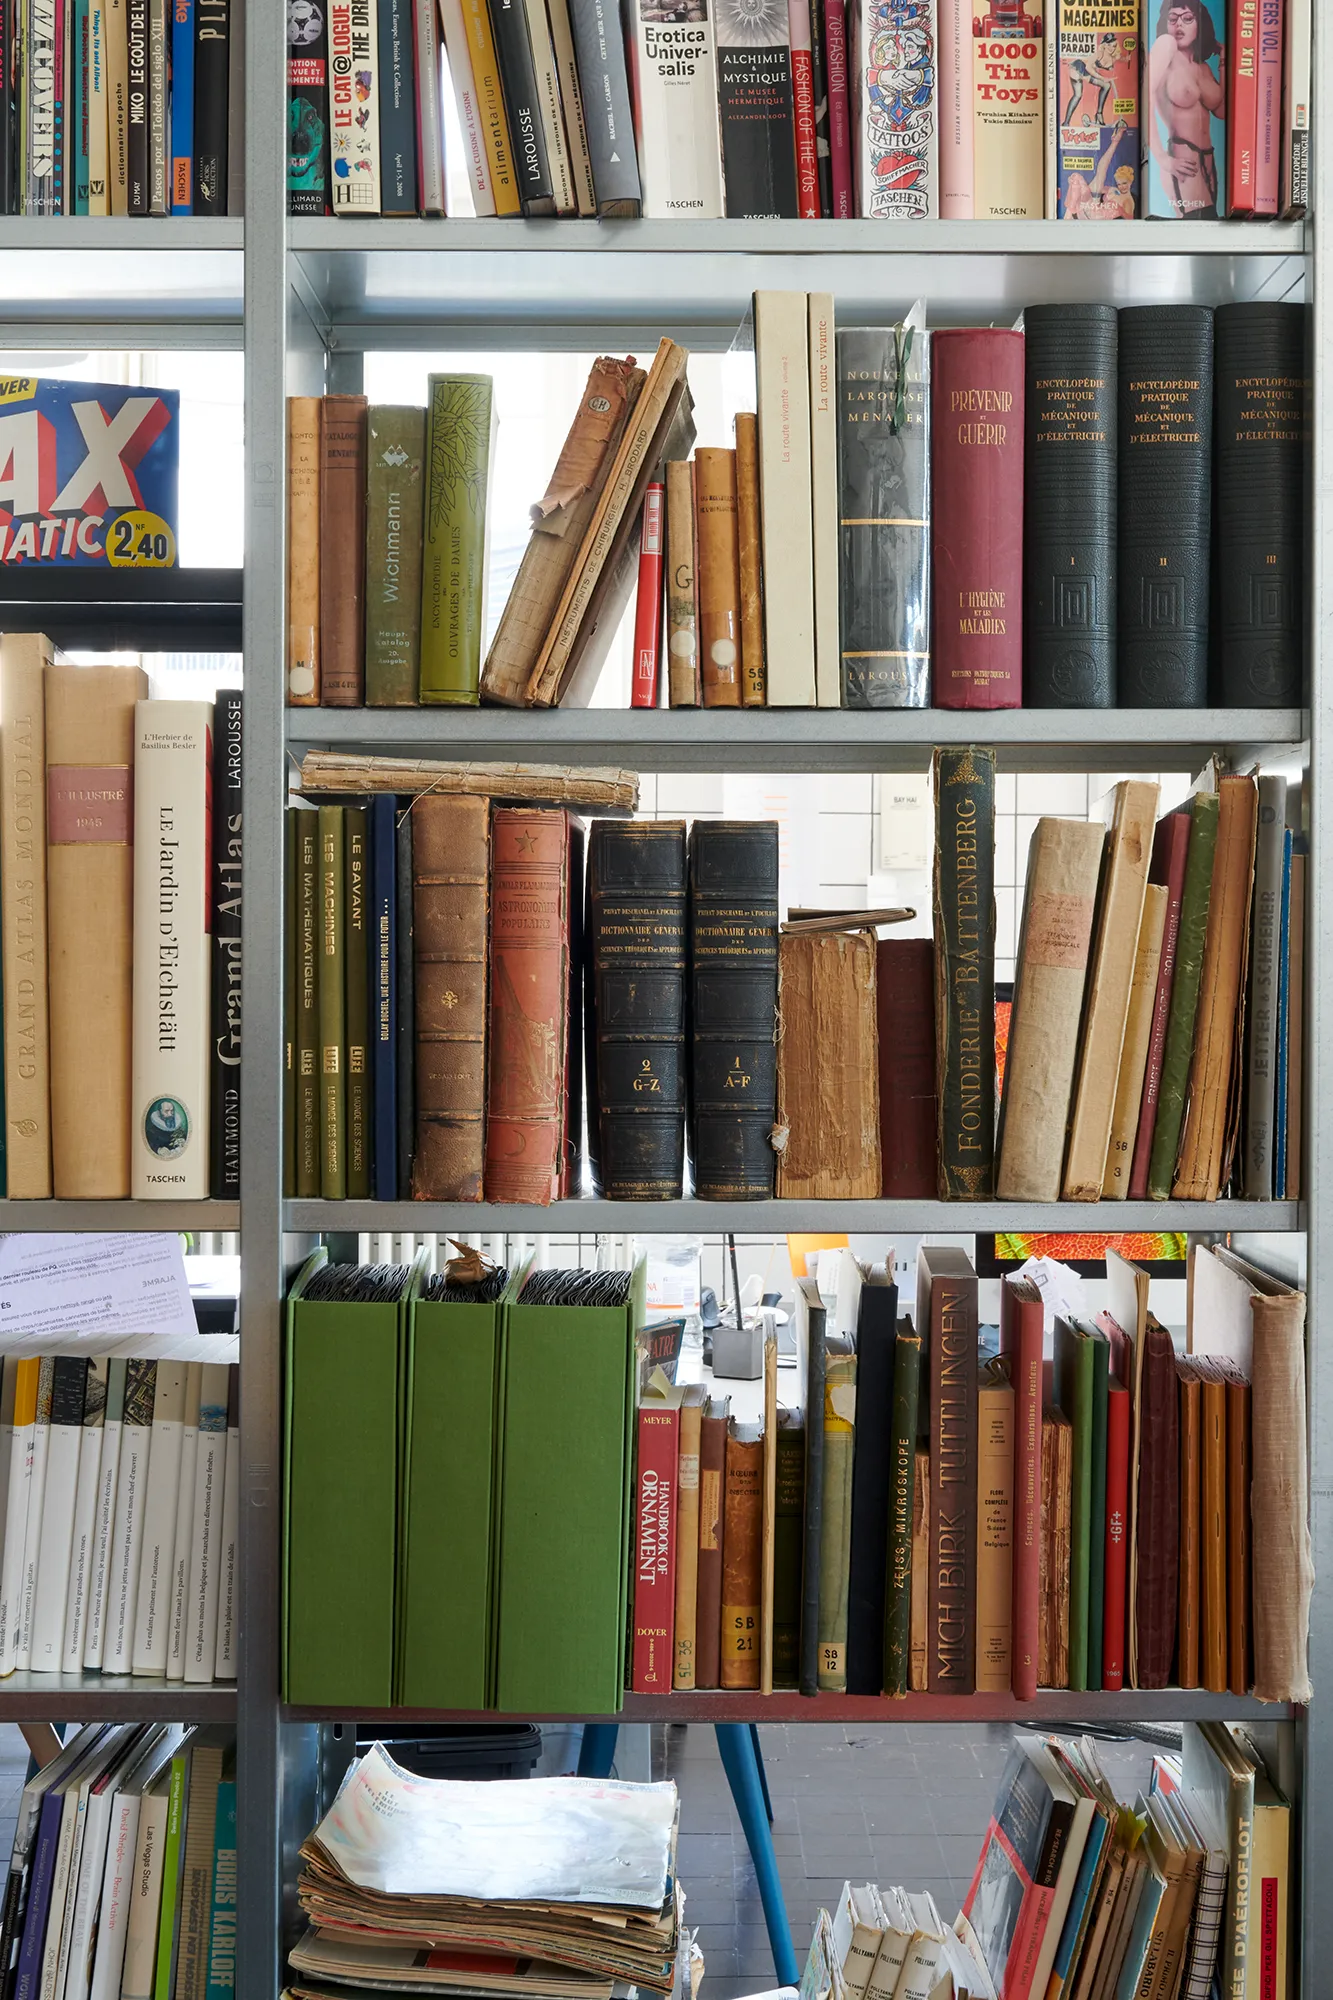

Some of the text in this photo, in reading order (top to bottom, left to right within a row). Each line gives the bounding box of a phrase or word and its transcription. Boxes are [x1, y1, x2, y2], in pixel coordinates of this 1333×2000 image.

[1063, 9, 1135, 28] MAGAZINES
[644, 26, 706, 43] Erotica
[1060, 33, 1095, 42] BEAUTY
[393, 40, 401, 63] British
[646, 43, 708, 59] Univer-
[723, 53, 786, 64] ALCHIMIE
[977, 42, 1038, 60] 1000
[1060, 43, 1095, 54] PARADE
[332, 4, 352, 128] LE CAT@LOGUE
[393, 63, 401, 71] &
[657, 61, 695, 76] salis
[984, 63, 1031, 80] Tin
[602, 74, 612, 102] CARSON
[723, 72, 788, 85] MYSTIQUE
[795, 56, 812, 113] FASHION
[393, 72, 402, 109] Collections
[976, 83, 1039, 104] Toys
[151, 19, 165, 203] Paseos por el Toledo del siglo XIII
[549, 97, 555, 107] LA
[550, 108, 557, 119] DE
[115, 82, 125, 186] dictionnaire de poche
[607, 112, 616, 140] RACHEL
[798, 117, 814, 135] OF
[870, 125, 928, 147] TATTOOS
[518, 107, 541, 181] LAROUSSE
[552, 121, 562, 155] HISTOIRE
[799, 139, 815, 164] THE
[1241, 150, 1250, 185] MILAN
[178, 162, 187, 200] TASCHEN
[559, 163, 570, 207] RENCONTRE
[665, 200, 704, 208] TASCHEN
[989, 207, 1027, 215] TASCHEN
[1168, 200, 1206, 208] TASCHEN
[816, 320, 829, 412] La route vivante
[1035, 378, 1106, 388] ENCYCLOPÉDIE
[1129, 379, 1200, 391] ENCYCLOPÉDIE
[780, 388, 789, 422] vivante
[950, 389, 1013, 412] PRÉVENIR
[1047, 391, 1095, 402] PRATIQUE
[1140, 393, 1189, 403] PRATIQUE
[1040, 410, 1101, 421] MÉCANIQUE
[1134, 411, 1195, 423] MÉCANIQUE
[781, 424, 790, 449] route
[957, 422, 1007, 445] GUÉRIR
[1036, 431, 1106, 442] D'ÉLECTRICITÉ
[1130, 432, 1200, 443] D'ÉLECTRICITÉ
[781, 451, 790, 463] La
[135, 523, 146, 531] NF
[382, 492, 401, 603] Wichmann
[559, 577, 591, 648] INSTRUMENTS
[587, 561, 597, 574] DE
[593, 503, 620, 557] CHIRURGIE
[618, 481, 628, 492] H.
[623, 429, 648, 478] BRODARD
[448, 526, 462, 658] OUVRAGES DE DAMES
[959, 619, 1006, 634] MALADIES
[141, 742, 197, 750] Basilius Besler
[144, 733, 193, 741] L'Herbier de
[227, 700, 241, 789] LAROUSSE
[160, 806, 174, 831] LE
[160, 837, 179, 915] Jardin
[352, 834, 362, 931] LE SAVANT
[13, 715, 36, 1079] GRAND ATLAS MONDIAL
[324, 834, 335, 956] LES MACHINES
[695, 927, 746, 936] DICTIONNAIRE
[955, 798, 982, 1152] FONDERIE BATTENBERG
[324, 1045, 339, 1073] LIFE
[350, 1045, 364, 1073] LIFE
[642, 1059, 651, 1072] 2
[224, 1088, 239, 1183] HAMMOND
[327, 1085, 338, 1173] LE MONDE DES SCIENCES
[353, 1085, 363, 1171] LE MONDE DES SCIENCES
[146, 1175, 186, 1183] TASCHEN
[1113, 1166, 1121, 1177] 3
[643, 1416, 672, 1425] MEYER
[203, 1491, 211, 1518] direction
[640, 1469, 659, 1585] ORNAMENT
[657, 1480, 670, 1575] HANDBOOK OF
[199, 1568, 208, 1594] Belgique
[175, 1598, 183, 1618] aimait
[146, 1616, 154, 1639] enfants
[198, 1620, 204, 1629] ou
[637, 1628, 667, 1636] DOVER
[195, 1629, 205, 1643] plus
[172, 1781, 180, 1798] Photo
[171, 1800, 179, 1816] Press
[141, 1825, 156, 1897] Las Vegas Studio
[75, 1851, 93, 1950] HOME OF THE BRAVE
[210, 1848, 237, 1988] BORIS KARLOFF
